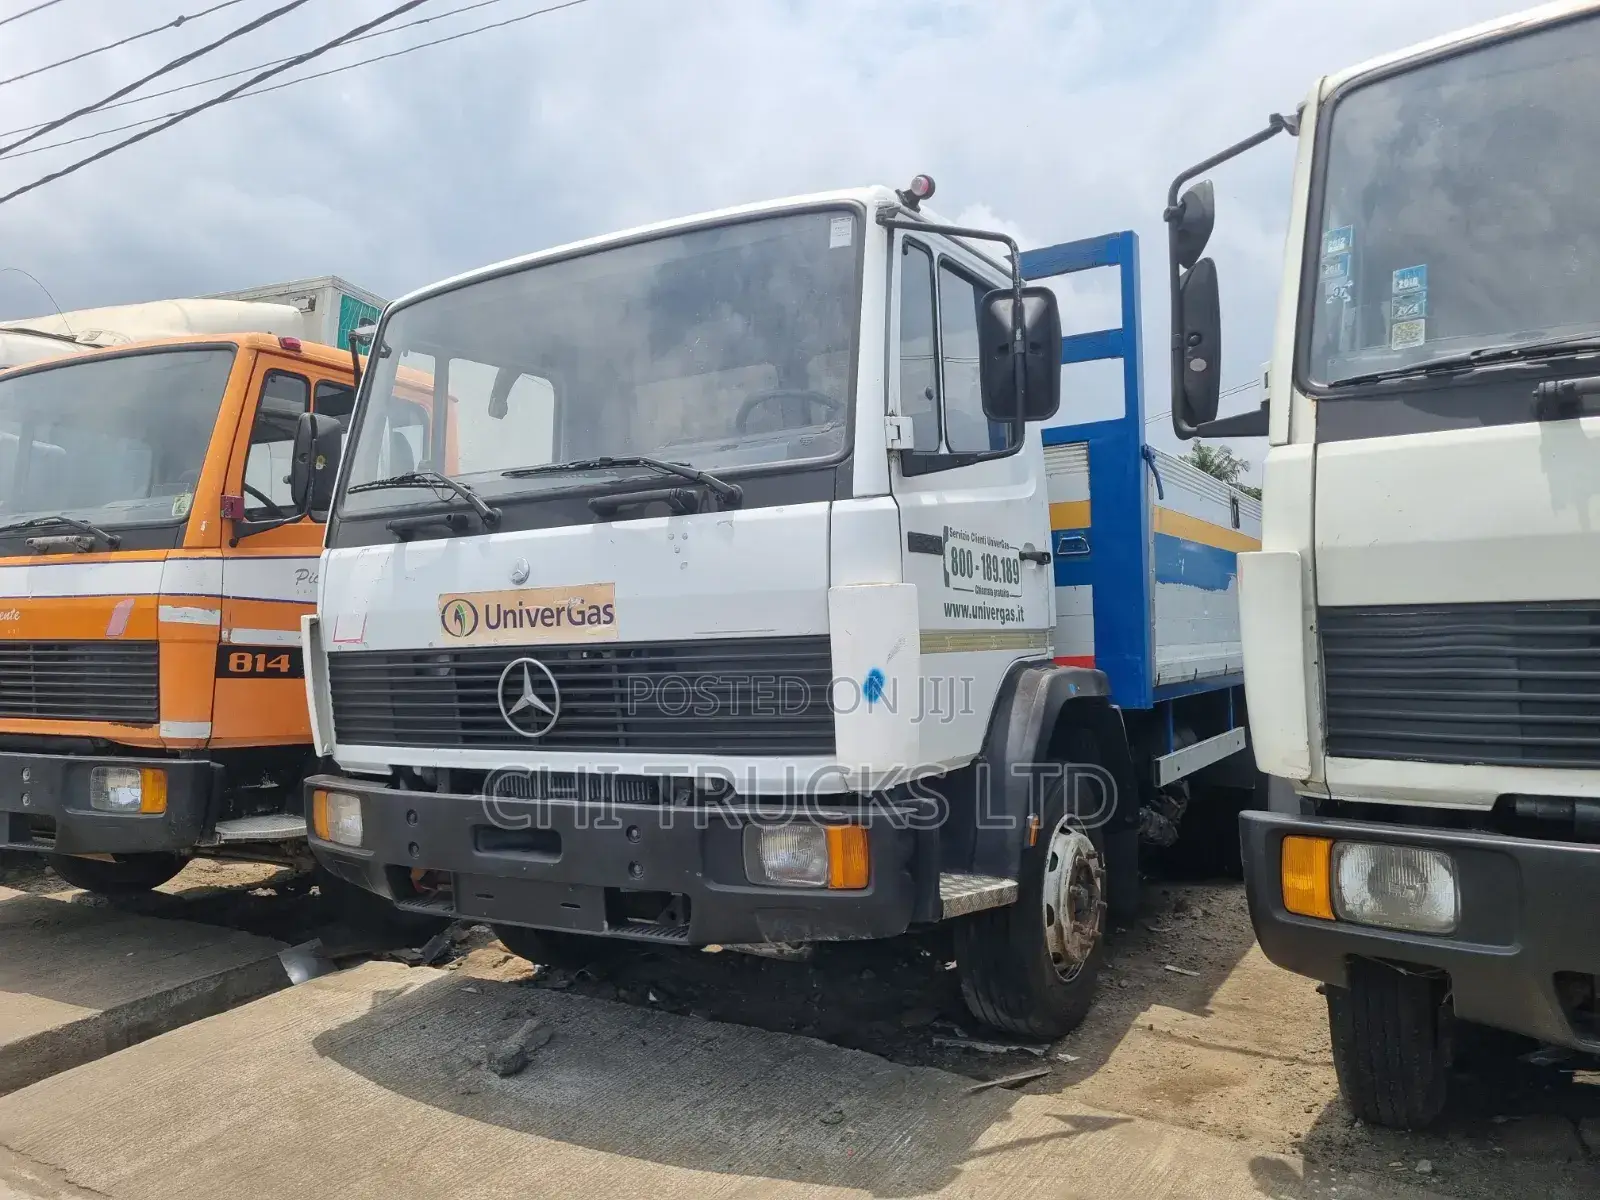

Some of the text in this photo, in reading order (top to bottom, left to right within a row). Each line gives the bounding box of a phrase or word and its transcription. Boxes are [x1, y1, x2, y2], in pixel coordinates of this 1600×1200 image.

[484, 598, 616, 631] UniverGas
[943, 601, 1025, 625] www.univergas.it
[228, 652, 291, 673] 814
